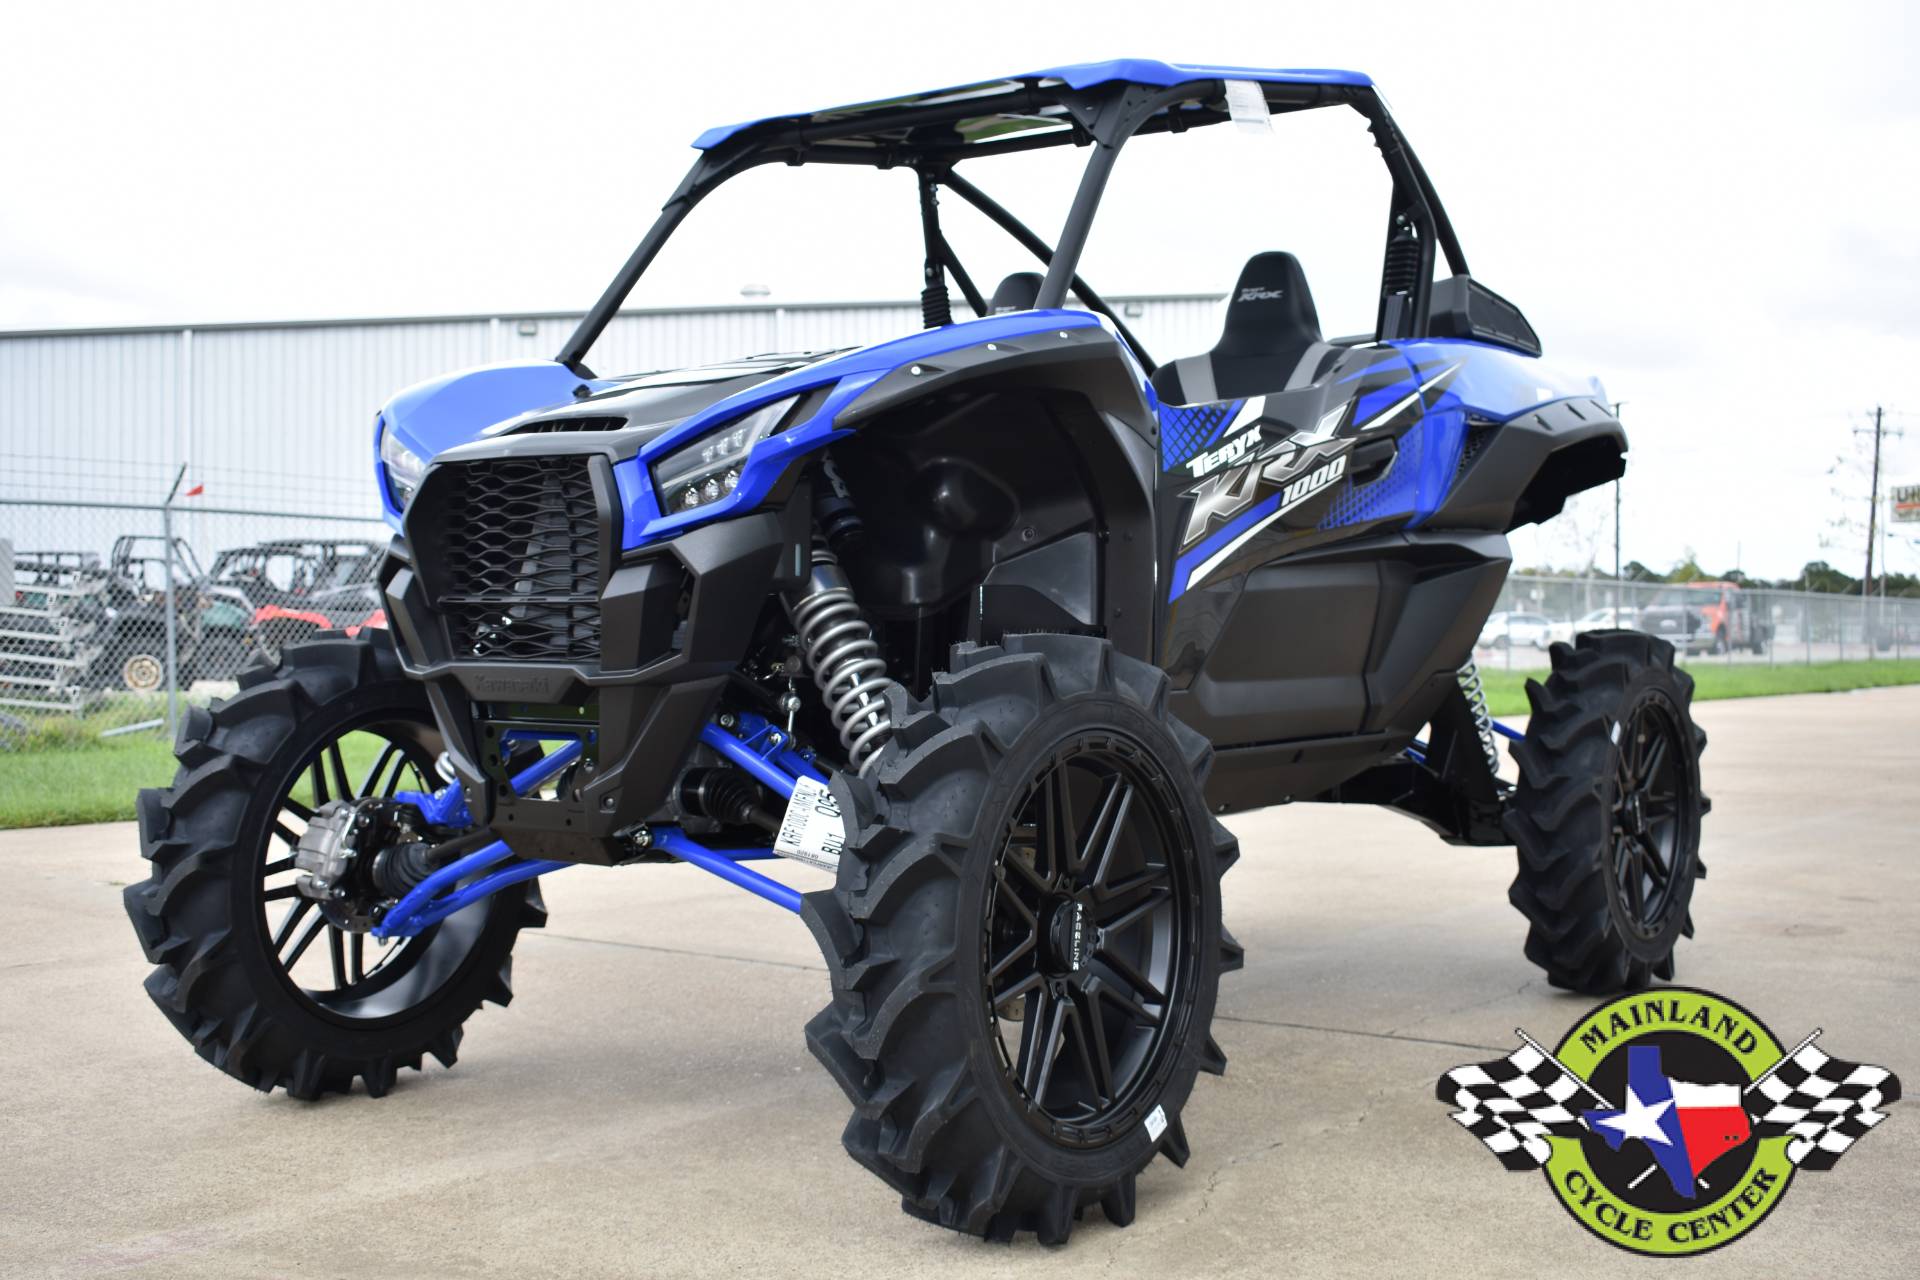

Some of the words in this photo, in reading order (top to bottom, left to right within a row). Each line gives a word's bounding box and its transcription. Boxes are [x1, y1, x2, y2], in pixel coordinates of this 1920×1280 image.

[1177, 401, 1357, 549] KRX
[1186, 425, 1262, 478] TERYX
[1280, 455, 1347, 507] 1000
